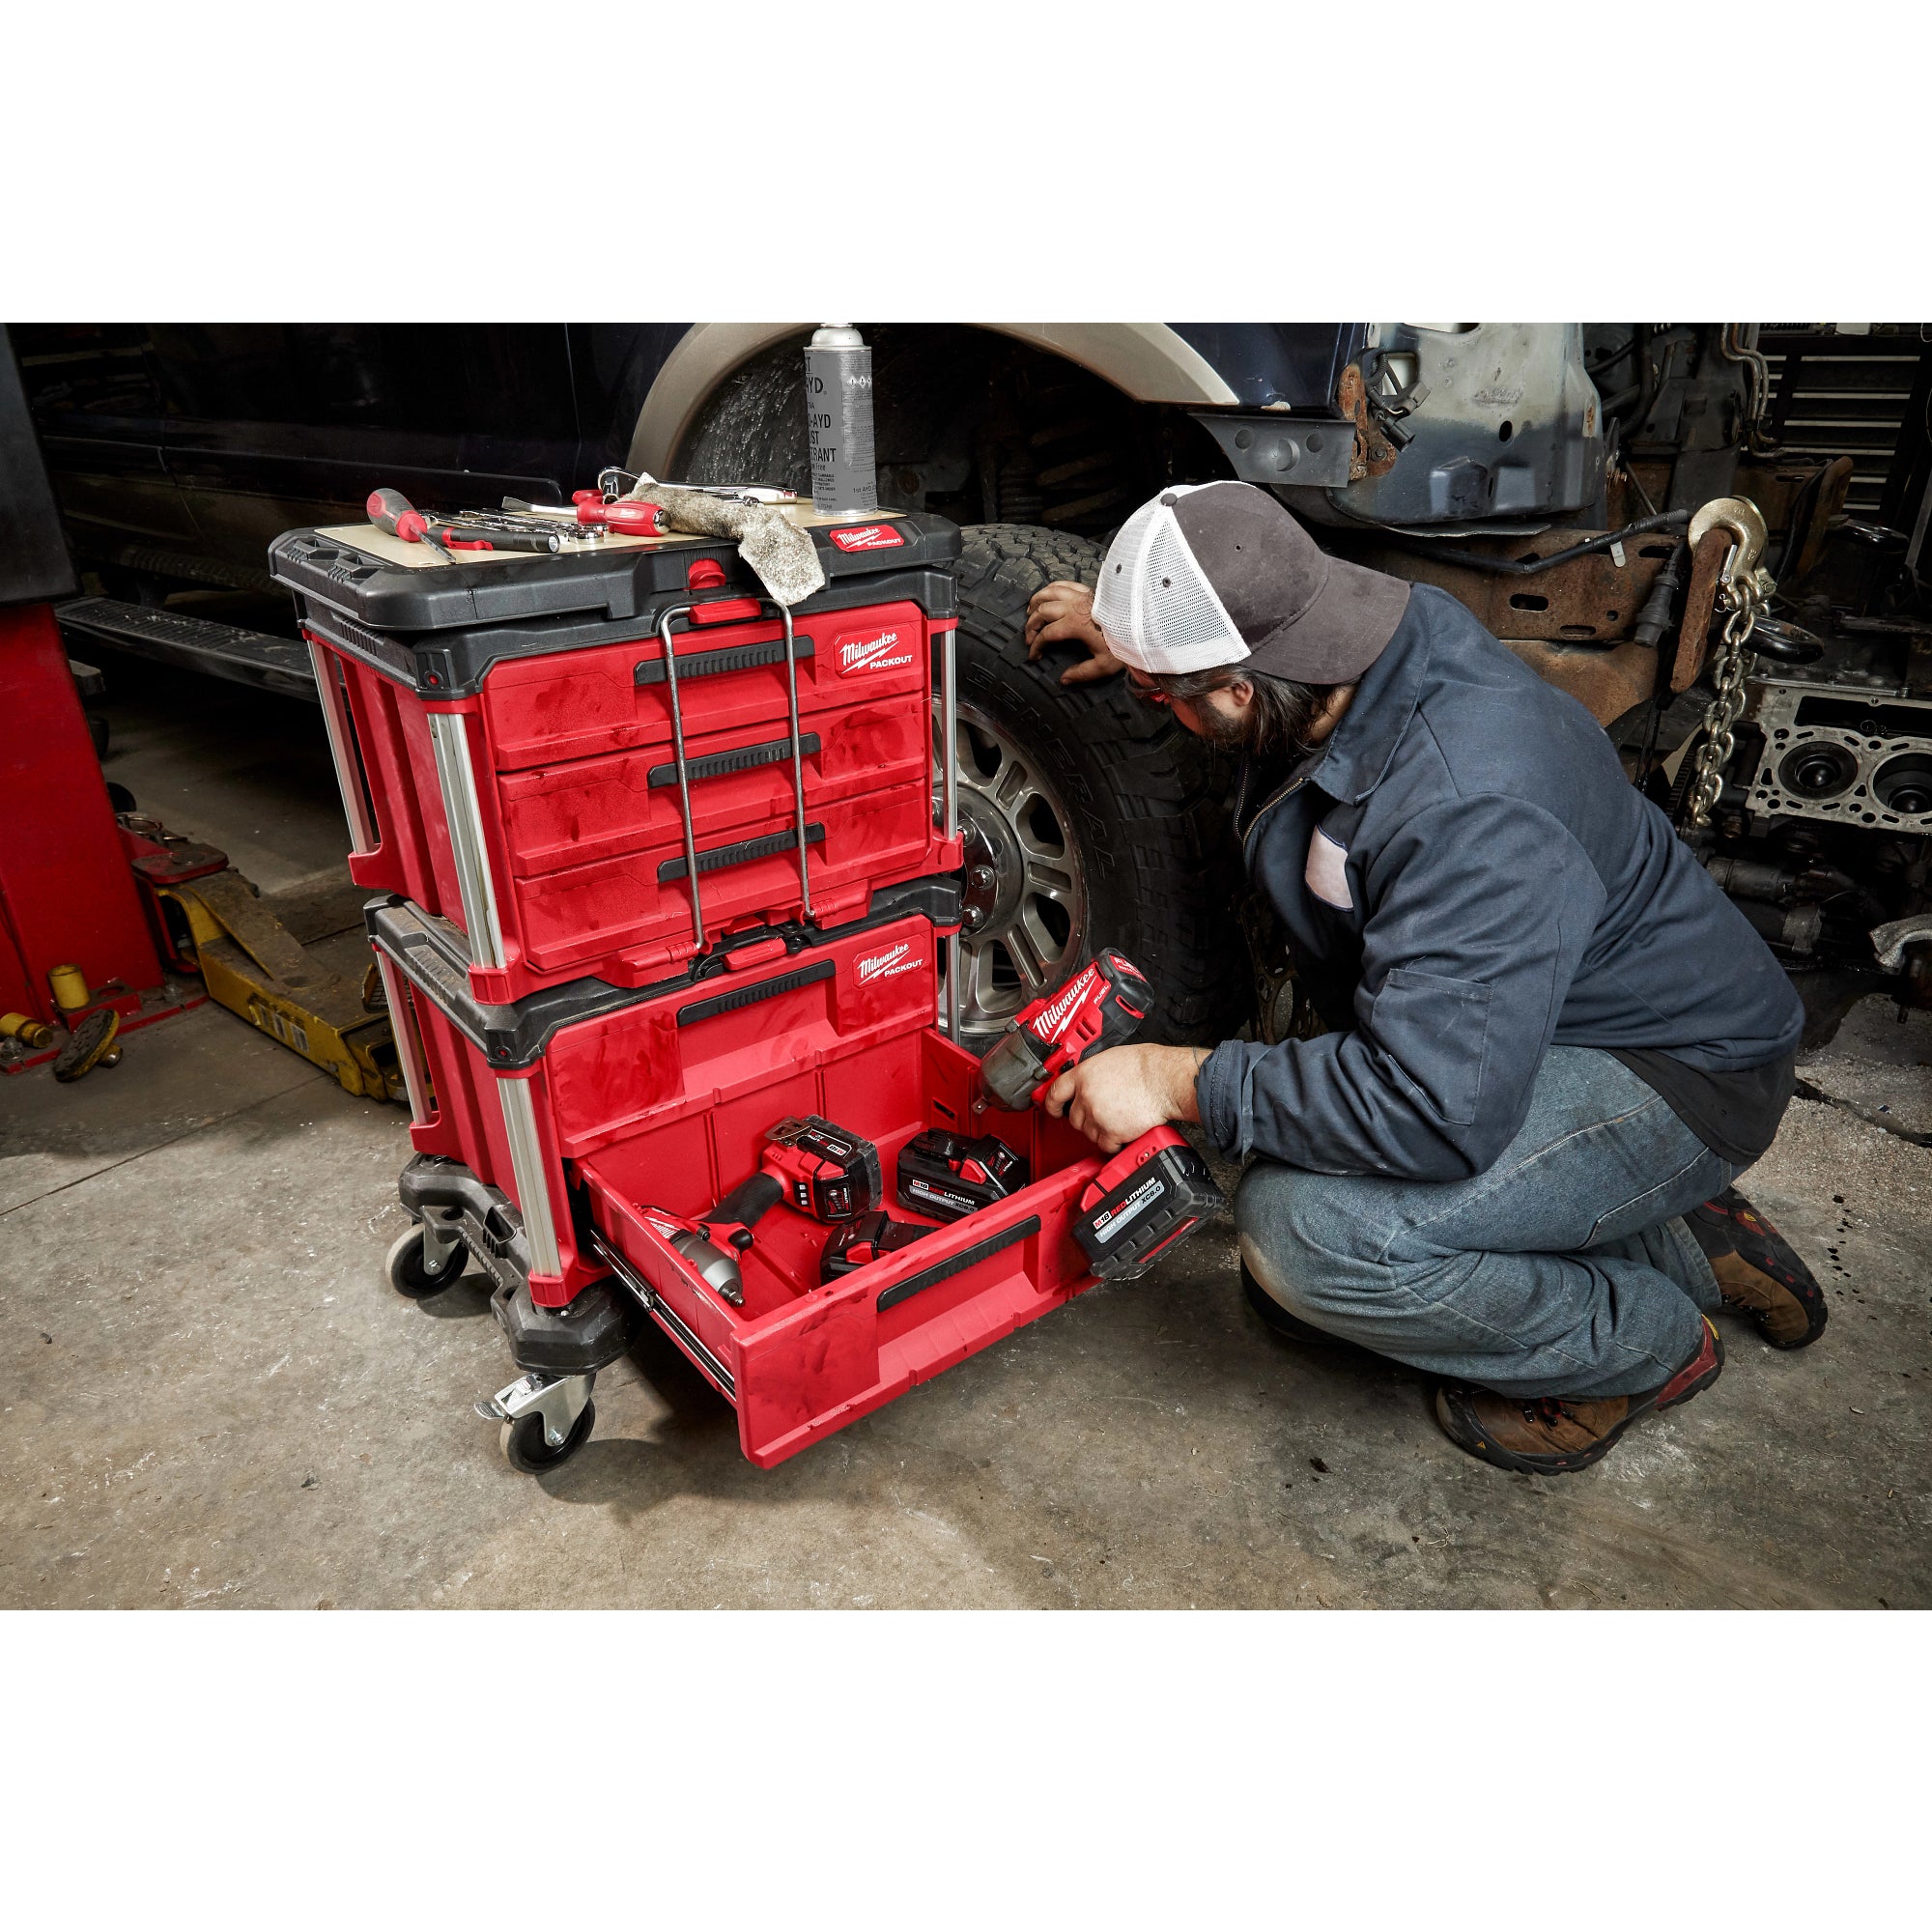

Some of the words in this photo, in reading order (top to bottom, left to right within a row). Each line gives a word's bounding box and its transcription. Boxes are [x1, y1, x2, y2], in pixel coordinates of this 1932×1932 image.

[809, 413, 831, 429] -AYD
[810, 430, 819, 445] ST
[837, 527, 880, 545] Milwaukee
[867, 538, 901, 547] PACKOUT
[839, 632, 897, 666] Milwaukee
[870, 654, 913, 669] PACKOUT
[858, 943, 909, 978] Milwaukee
[885, 958, 923, 977] PACKOUT
[1033, 968, 1094, 1038] Milwaukee
[1093, 985, 1109, 1005] FUEL
[913, 1180, 928, 1189] M18
[912, 1188, 928, 1197] HIGH
[929, 1193, 954, 1206] OUTPUT
[1094, 1212, 1110, 1228] M18
[1099, 1222, 1117, 1237] HIGH
[1117, 1201, 1141, 1224] OUTPUT
